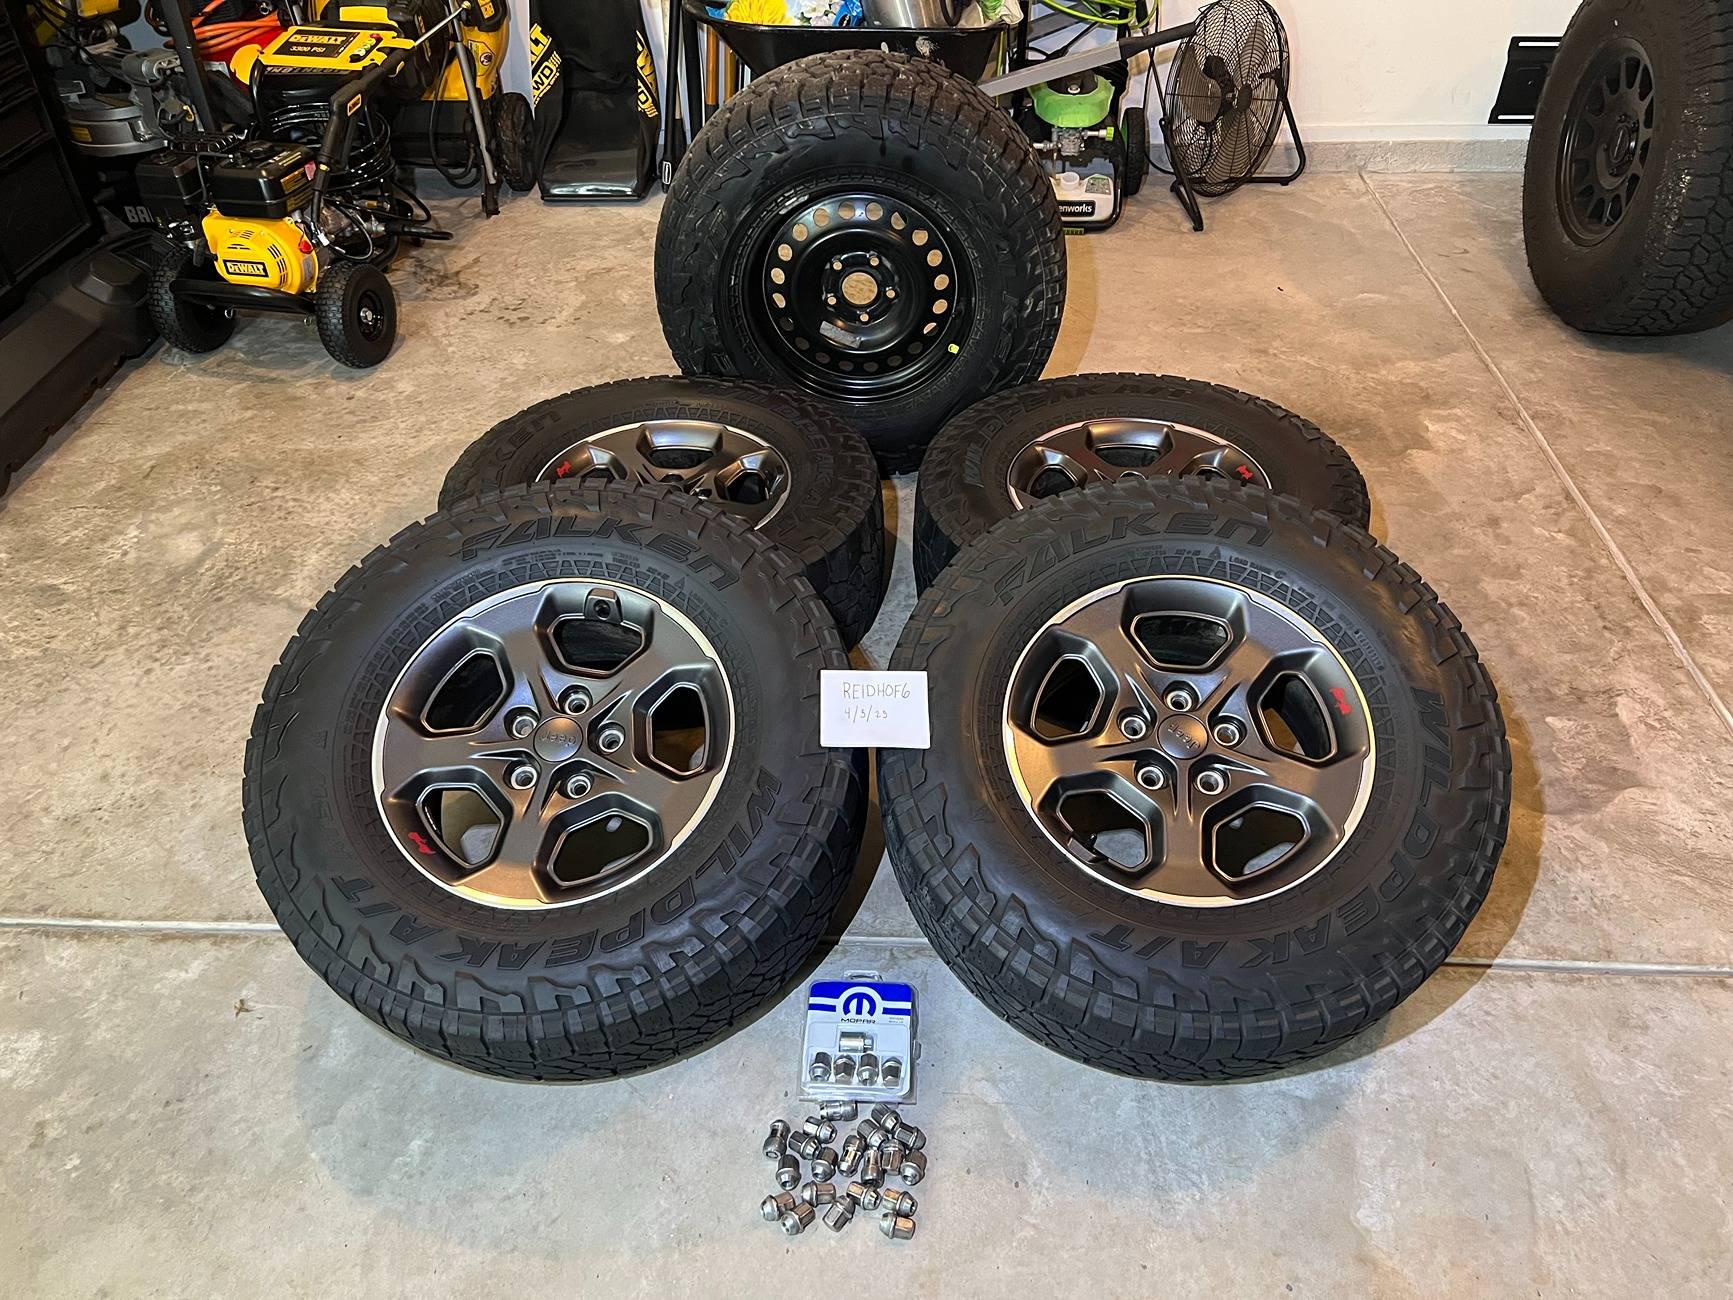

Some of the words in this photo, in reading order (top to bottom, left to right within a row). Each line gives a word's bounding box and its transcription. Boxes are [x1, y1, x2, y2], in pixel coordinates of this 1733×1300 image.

[1059, 204, 1093, 213] enworks
[228, 261, 264, 275] DEWALT
[449, 514, 743, 592] FALKEN
[994, 511, 1275, 607] FALKEN
[843, 681, 911, 700] REIDHOF6
[1239, 685, 1454, 970] WILDPEAK
[432, 766, 782, 971] WILDPEAK
[329, 874, 443, 946] A/T
[1086, 923, 1229, 969] A/T
[840, 1017, 876, 1025] MOPAR
